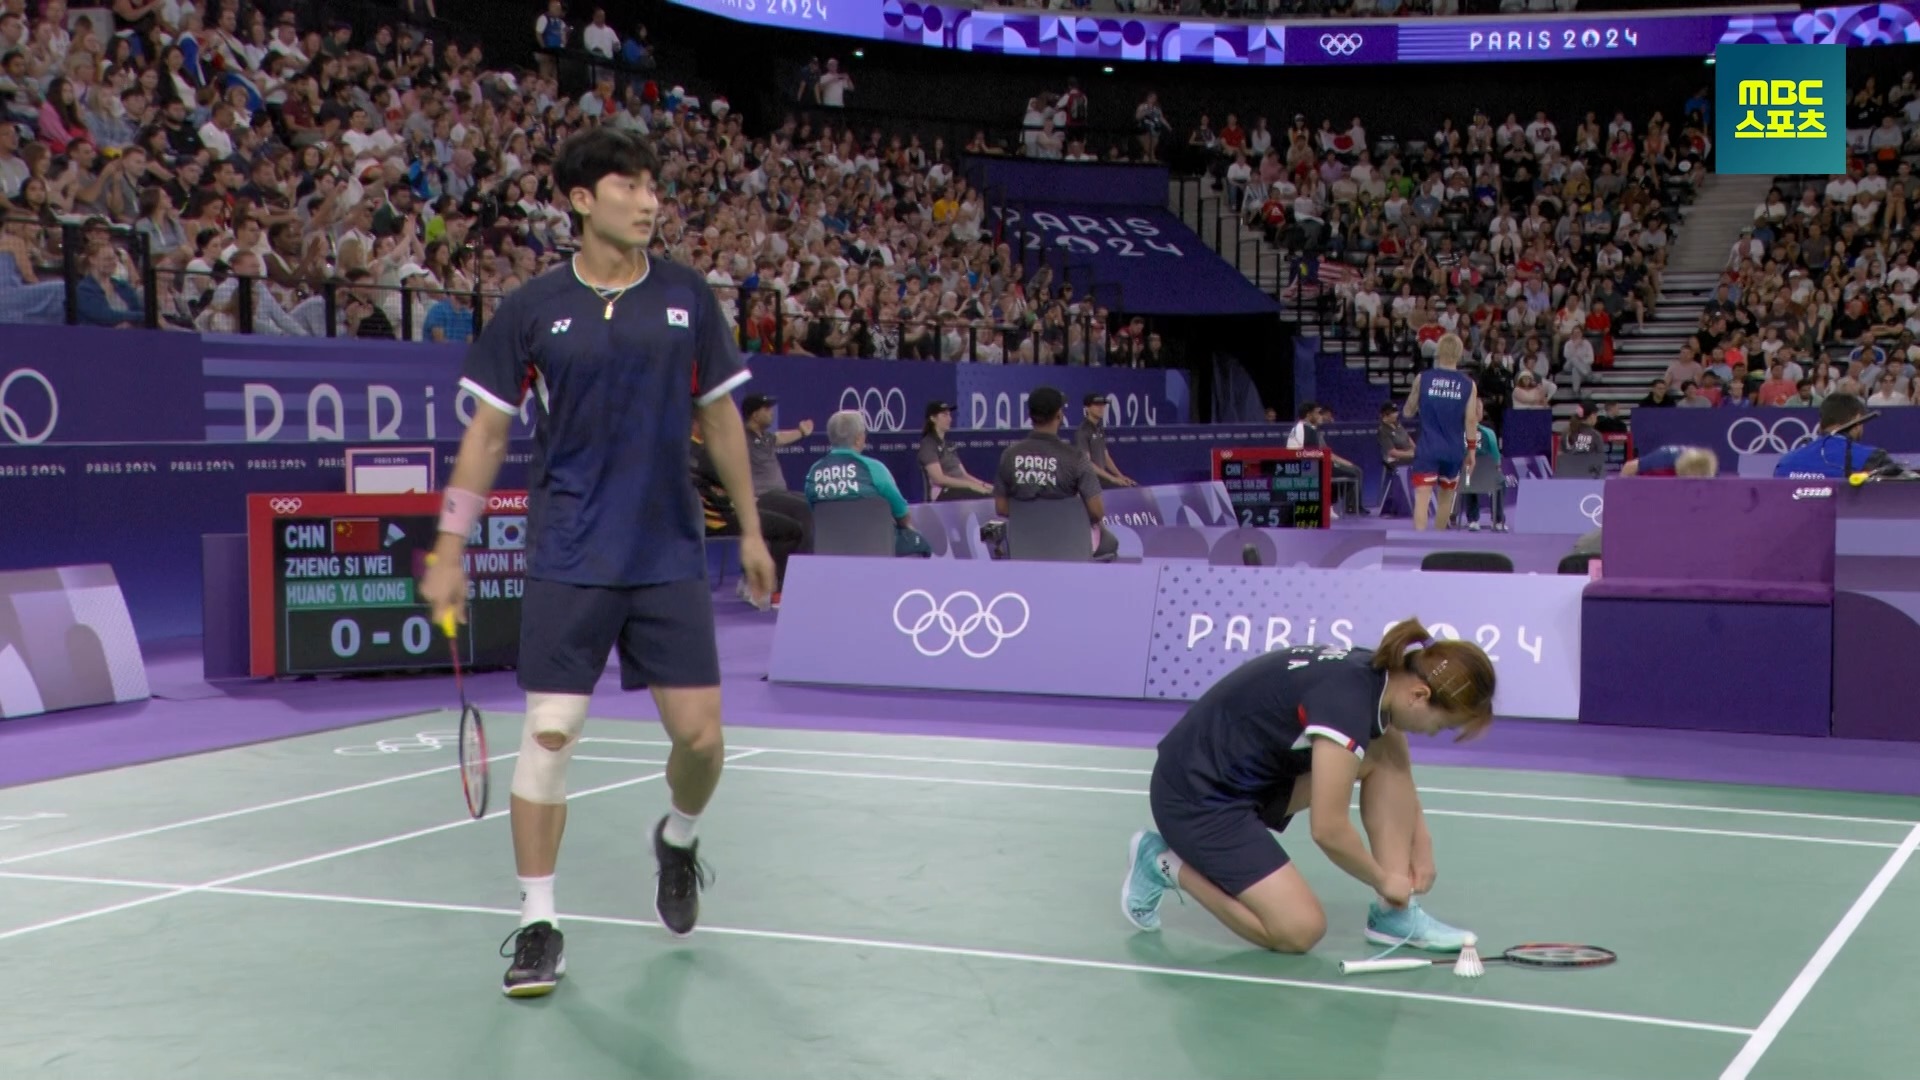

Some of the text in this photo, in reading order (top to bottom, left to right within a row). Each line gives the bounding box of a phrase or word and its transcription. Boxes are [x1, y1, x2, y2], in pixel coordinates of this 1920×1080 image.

[1469, 28, 1638, 51] PARIS 2024
[993, 206, 1160, 237] PARIS
[1015, 231, 1184, 257] 2024
[1428, 388, 1461, 400] MALAYSIA
[31, 464, 66, 476] 2024
[86, 462, 157, 475] PARIS 2024
[170, 460, 235, 473] PARIS 2024
[247, 459, 278, 471] PARIS
[814, 463, 857, 483] PARIS
[1014, 455, 1058, 473] PARIS
[1284, 463, 1300, 474] MAS
[1014, 470, 1058, 487] 2024
[815, 479, 859, 499] 2024
[1241, 509, 1254, 528] 2
[1268, 509, 1280, 528] 5
[285, 524, 326, 550] CHN
[285, 555, 392, 578] ZHENG SI WEI
[475, 553, 510, 573] WON
[286, 582, 406, 605] HUANG YA QIONG
[480, 580, 501, 599] NA
[330, 618, 361, 658] 0
[401, 616, 431, 655] 0
